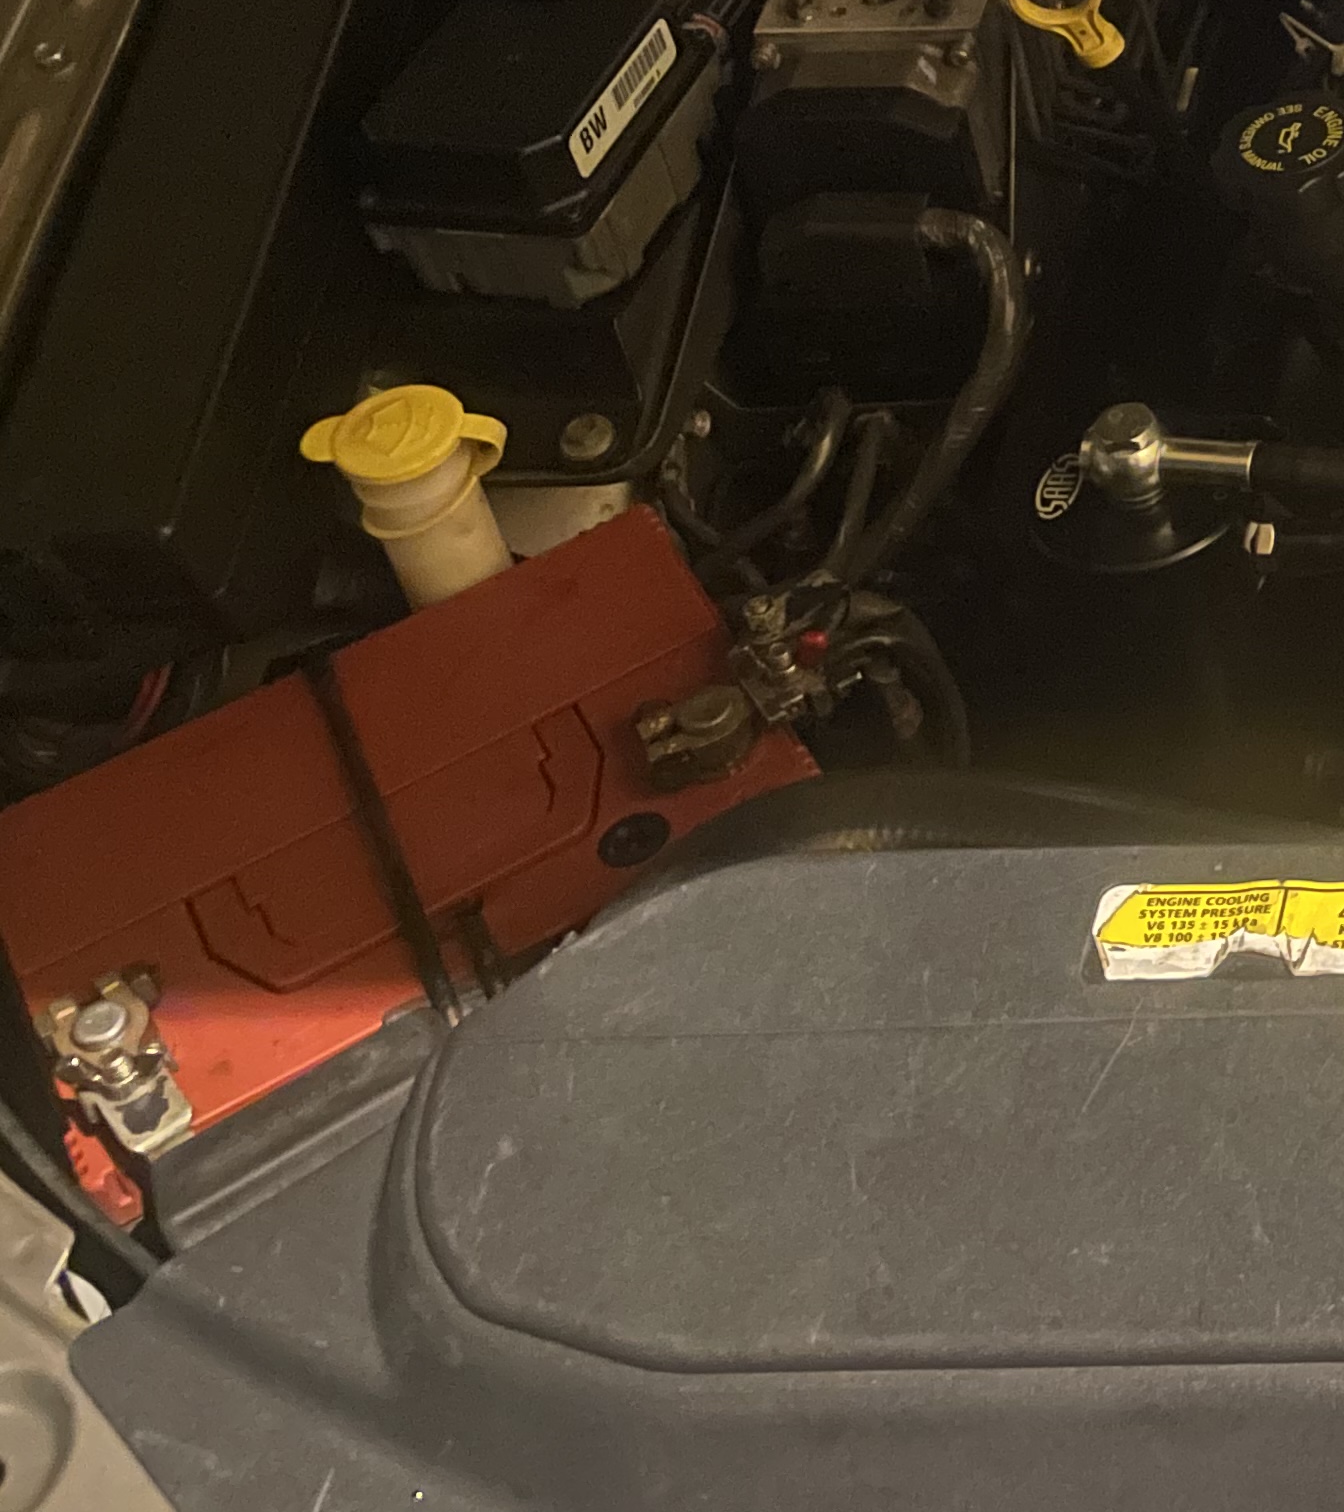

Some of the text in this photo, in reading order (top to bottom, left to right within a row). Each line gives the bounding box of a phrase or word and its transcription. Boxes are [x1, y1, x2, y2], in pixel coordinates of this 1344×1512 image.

[1276, 103, 1304, 116] SEE
[1297, 105, 1344, 166] ENGINE OIL
[1241, 148, 1285, 172] MANUAL
[1146, 892, 1271, 907] ENGINE COOLING
[1138, 903, 1272, 920] SYSTEM PRESSURE
[1146, 920, 1165, 930] V6
[1170, 920, 1196, 930] 135
[1212, 920, 1229, 930] 15
[1232, 916, 1258, 929] kPa
[1143, 932, 1163, 943] V8
[1168, 932, 1194, 943] 100
